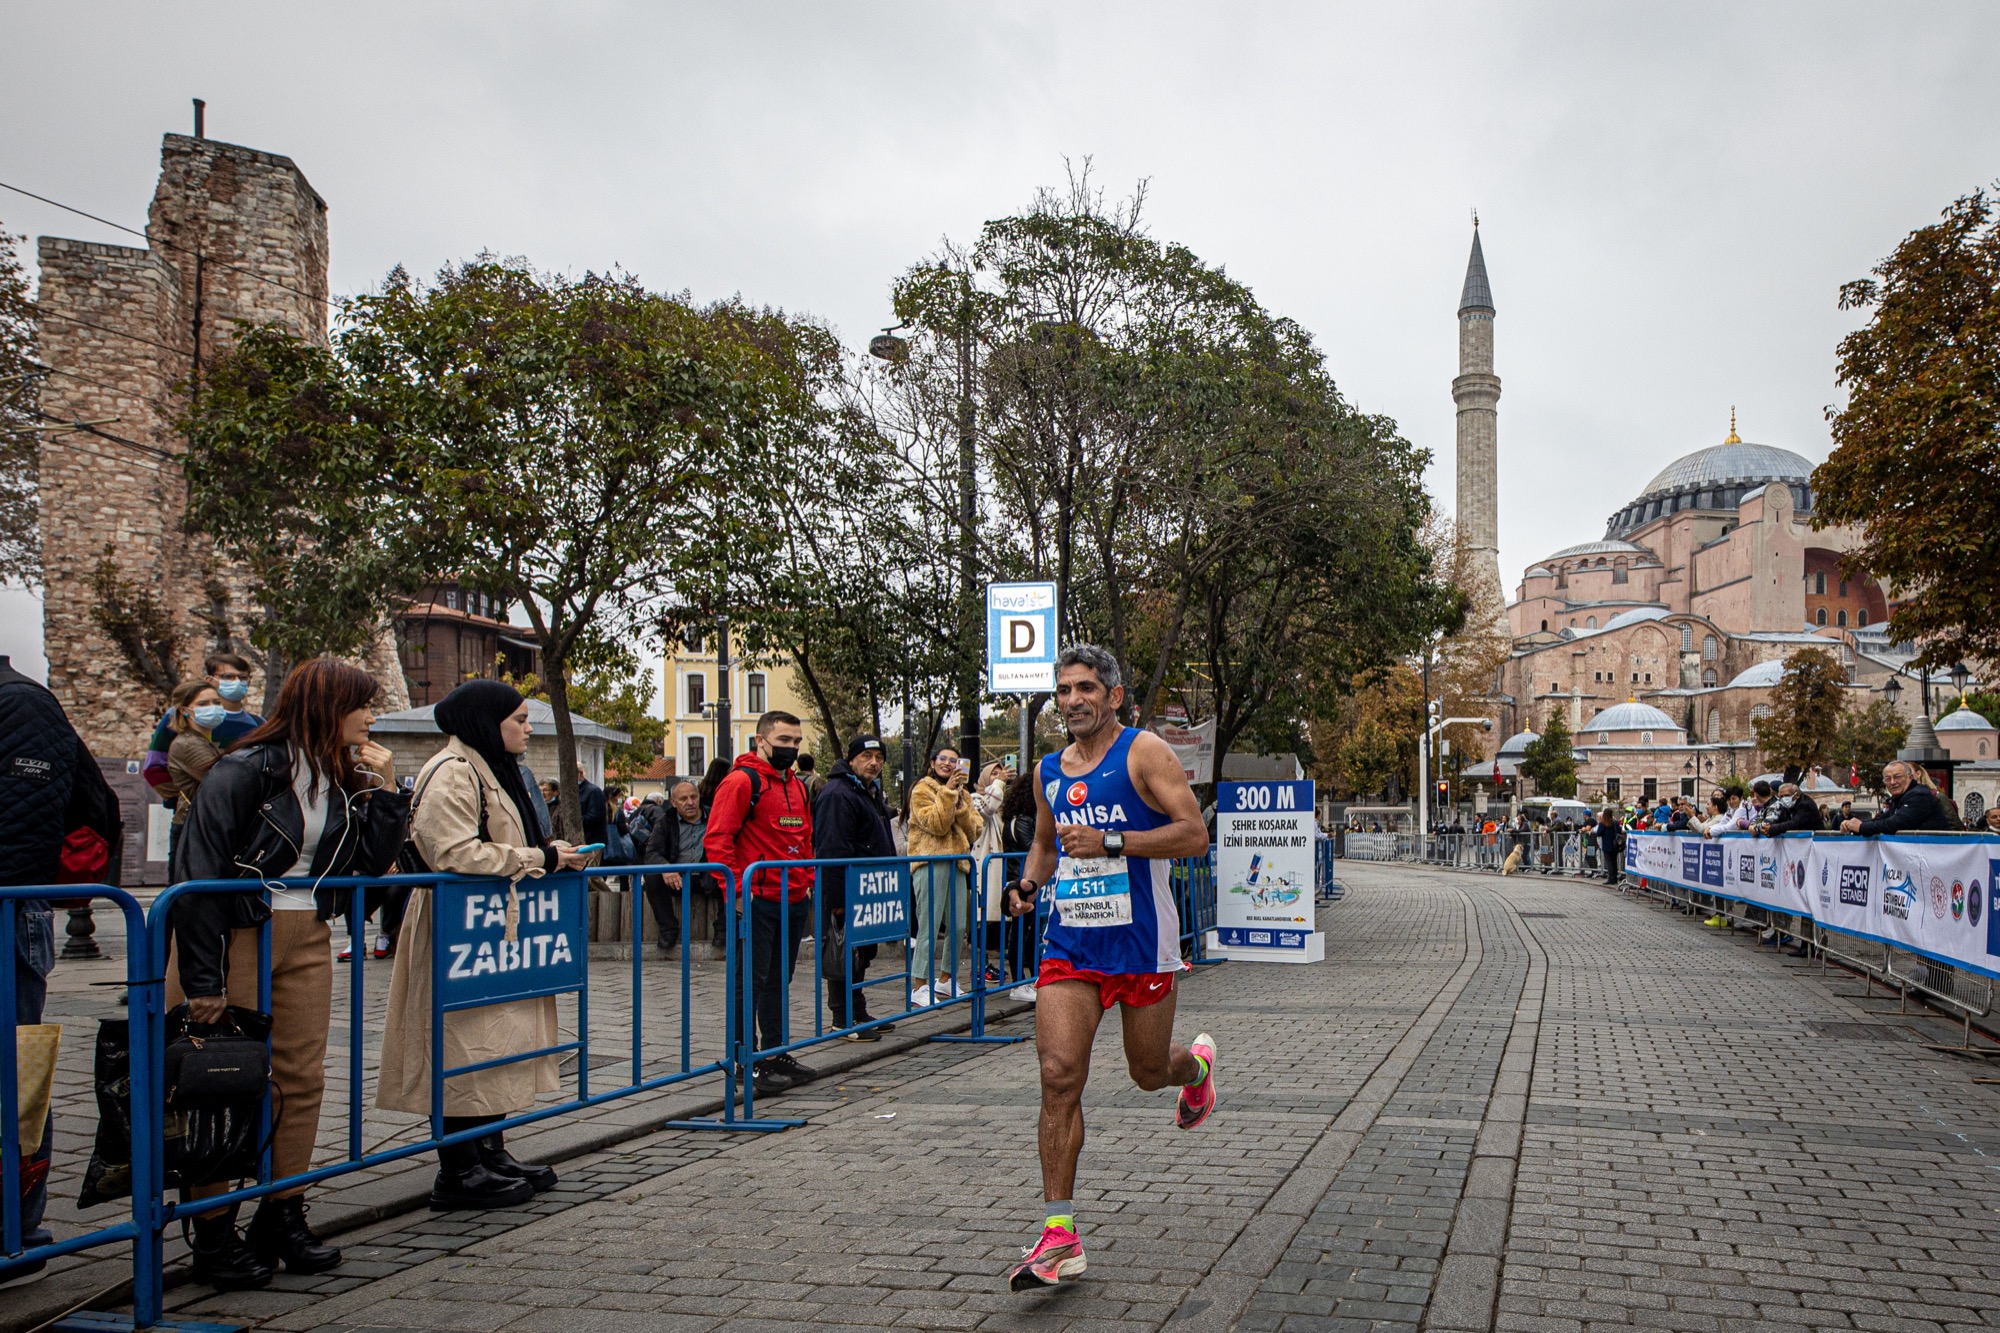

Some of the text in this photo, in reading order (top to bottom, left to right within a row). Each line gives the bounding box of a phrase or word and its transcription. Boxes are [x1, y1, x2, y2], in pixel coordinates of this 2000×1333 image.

[1010, 620, 1036, 654] D
[998, 673, 1050, 681] SULTANAHMET
[1235, 785, 1296, 810] 300 M
[1055, 803, 1128, 826] ANİSA
[1232, 819, 1299, 833] ŞEHRE KOŞARAK
[1223, 834, 1307, 848] İZİNİ BIRAKMAK MI?
[1069, 880, 1105, 895] A 511
[1842, 868, 1868, 890] SPOR
[853, 900, 904, 928] ZABITA
[1075, 901, 1112, 912] ISTANBUL
[1075, 910, 1114, 920] MARATHON
[449, 933, 572, 979] ZABITA
